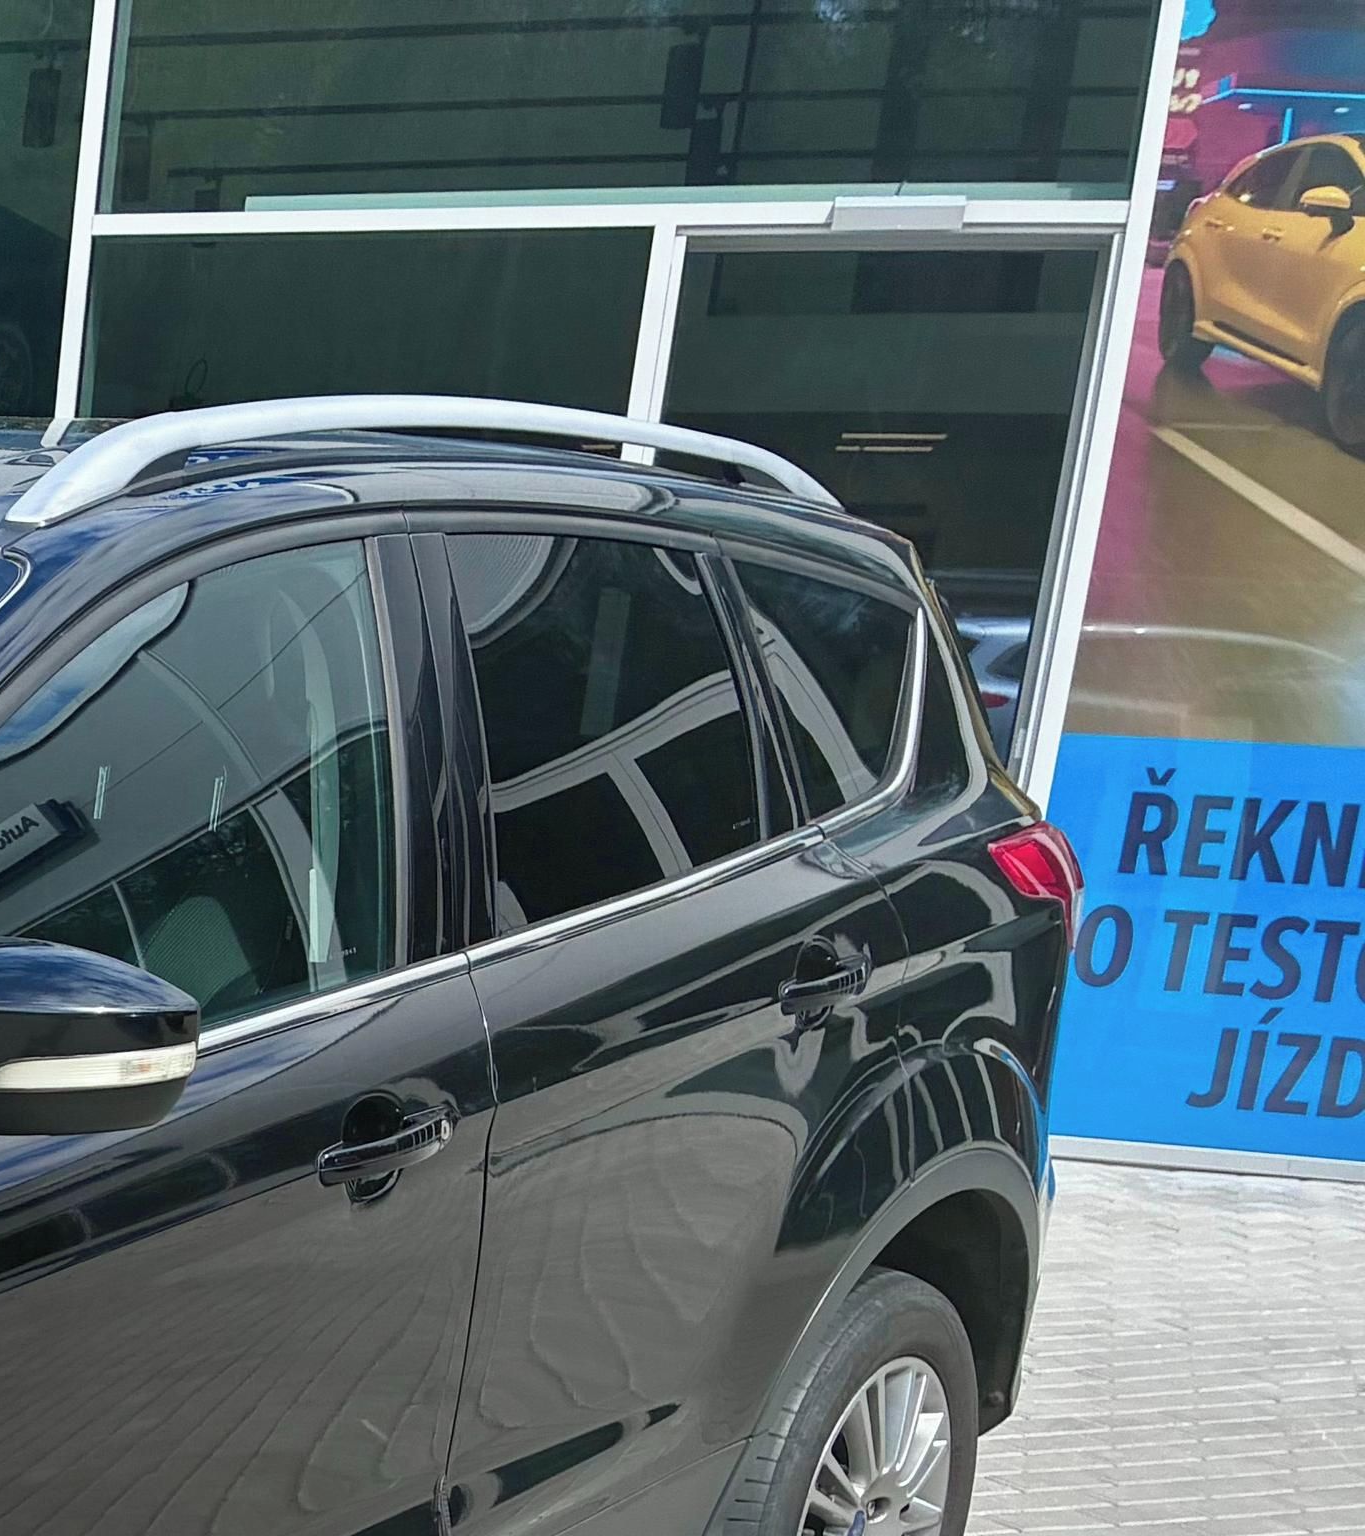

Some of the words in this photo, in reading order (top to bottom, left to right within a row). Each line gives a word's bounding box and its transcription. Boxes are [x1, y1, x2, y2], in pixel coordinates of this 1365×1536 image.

[1118, 767, 1365, 888] ŘEKN
[1075, 904, 1134, 988] O
[1163, 908, 1365, 1004] TEST
